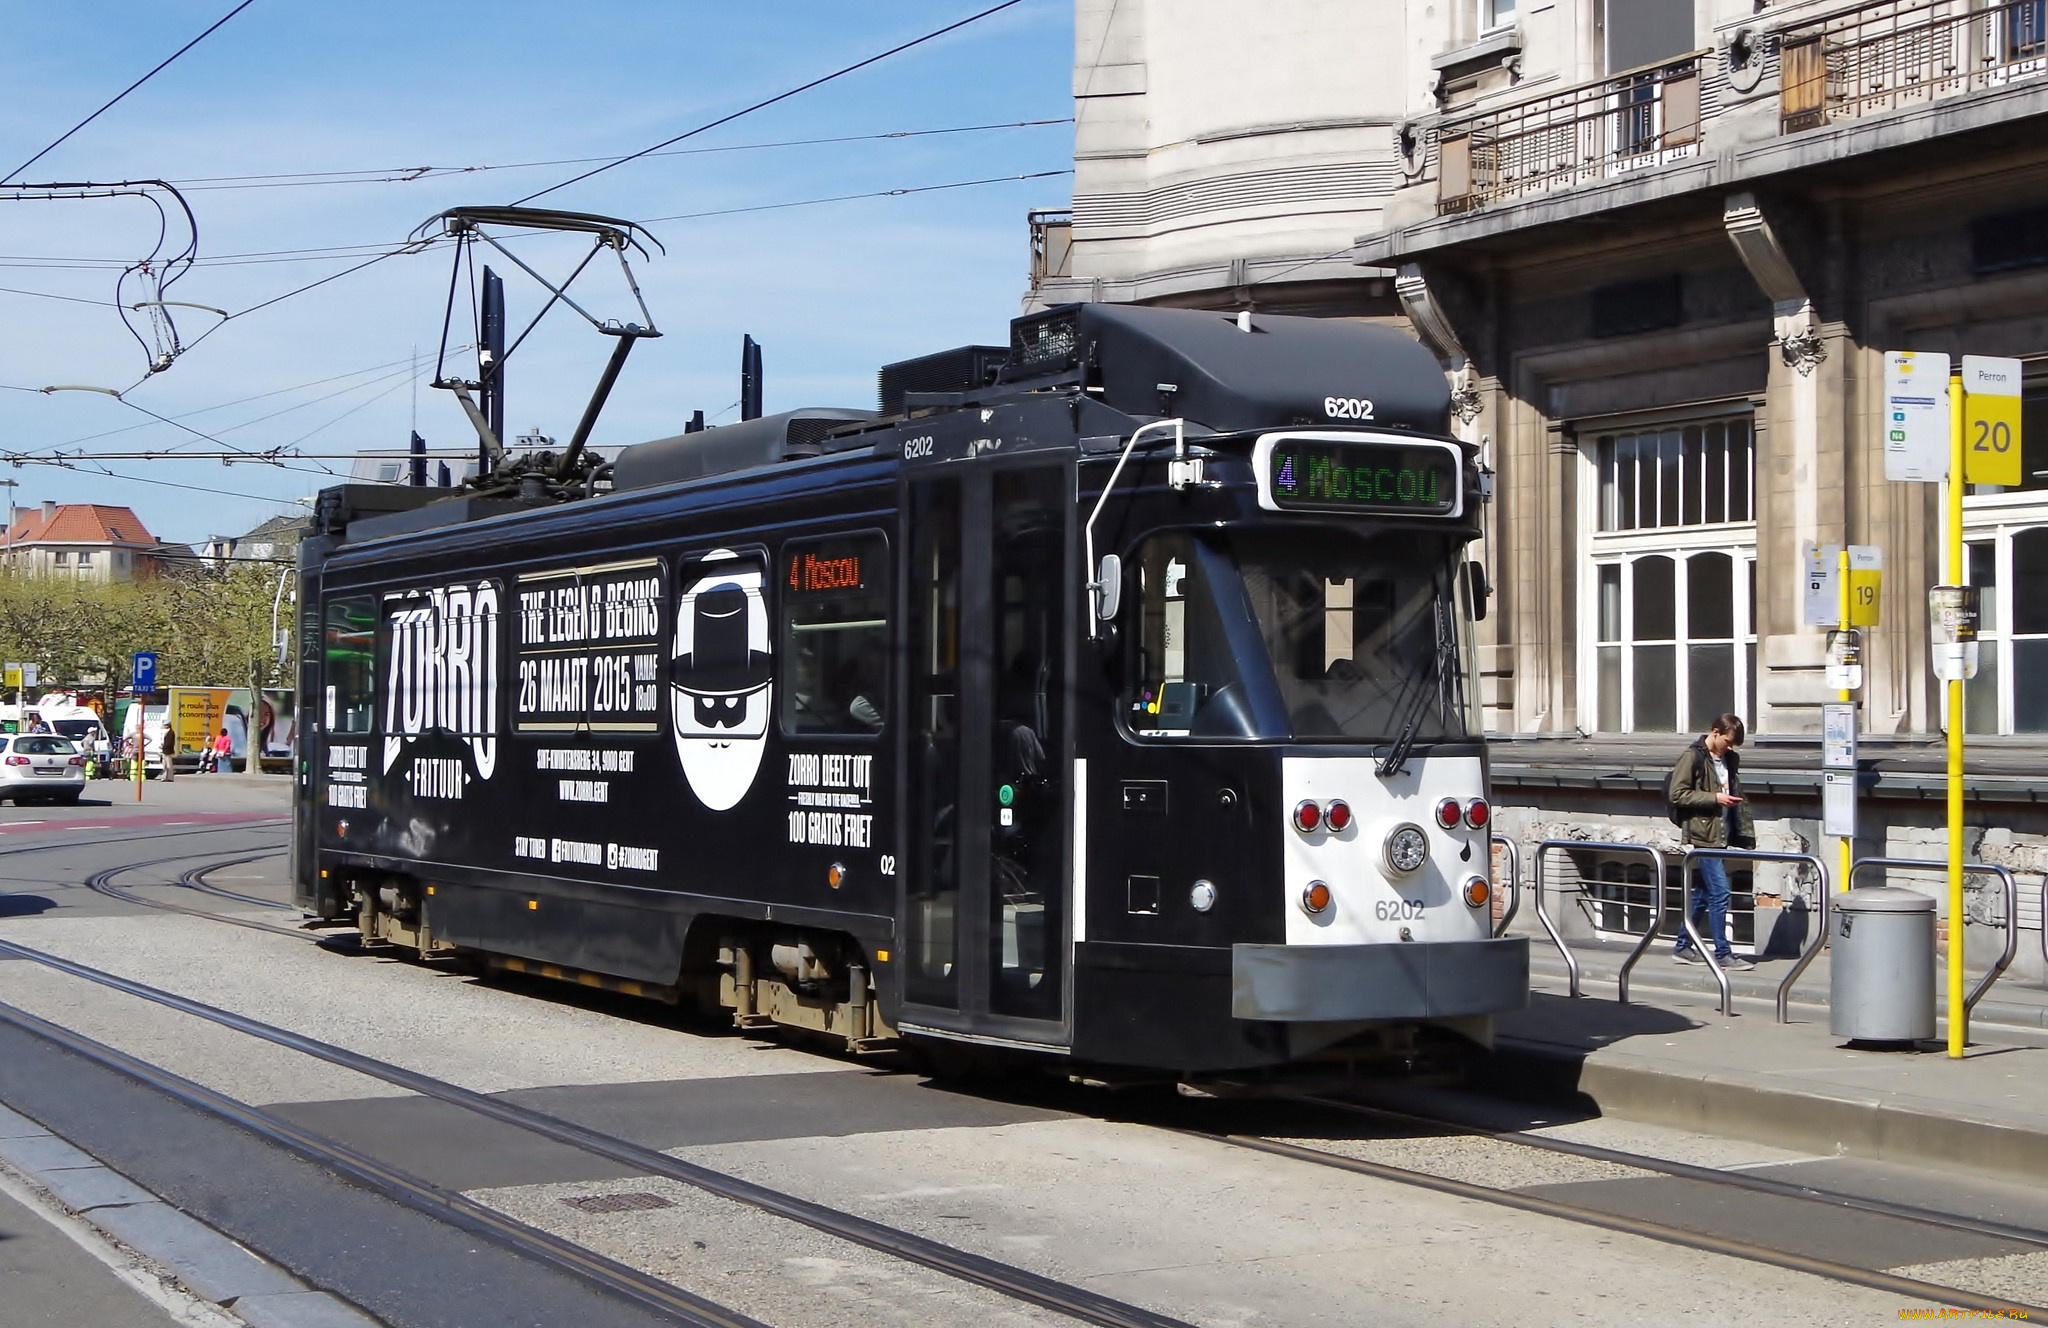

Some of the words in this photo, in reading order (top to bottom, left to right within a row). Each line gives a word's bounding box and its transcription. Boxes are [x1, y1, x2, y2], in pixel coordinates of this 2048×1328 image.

[1978, 370, 2007, 382] Perron
[1324, 397, 1374, 420] 6202
[904, 436, 933, 460] 6202
[1891, 432, 1903, 441] N4
[1973, 420, 2011, 453] 20
[1278, 455, 1297, 492] 4
[1308, 455, 1437, 502] Moscou
[789, 555, 799, 591] 4
[805, 553, 859, 590] Moscou
[1857, 586, 1874, 605] 19
[520, 591, 545, 644] THE
[549, 585, 601, 642] LEGEND
[606, 578, 660, 638] BEGINS
[137, 657, 152, 678] P
[383, 580, 498, 780] ZORRO
[634, 654, 658, 681] VANAF
[519, 660, 537, 712] 26
[540, 657, 588, 712] MAART
[593, 655, 630, 711] 2015
[206, 702, 219, 711] plus
[602, 750, 618, 772] 9000
[618, 750, 634, 772] GENT
[788, 754, 820, 786] ZORRO
[822, 754, 852, 788] DEELT
[852, 755, 873, 788] UIT
[413, 758, 463, 799] FRITUUR
[788, 811, 806, 843] 100
[808, 811, 842, 846] GRATIS
[844, 814, 873, 848] FRIET
[515, 836, 529, 857] STAY
[529, 837, 546, 859] TUNED
[618, 846, 659, 872] #ZORROGENT
[880, 854, 895, 875] 02
[1375, 900, 1425, 921] 6202
